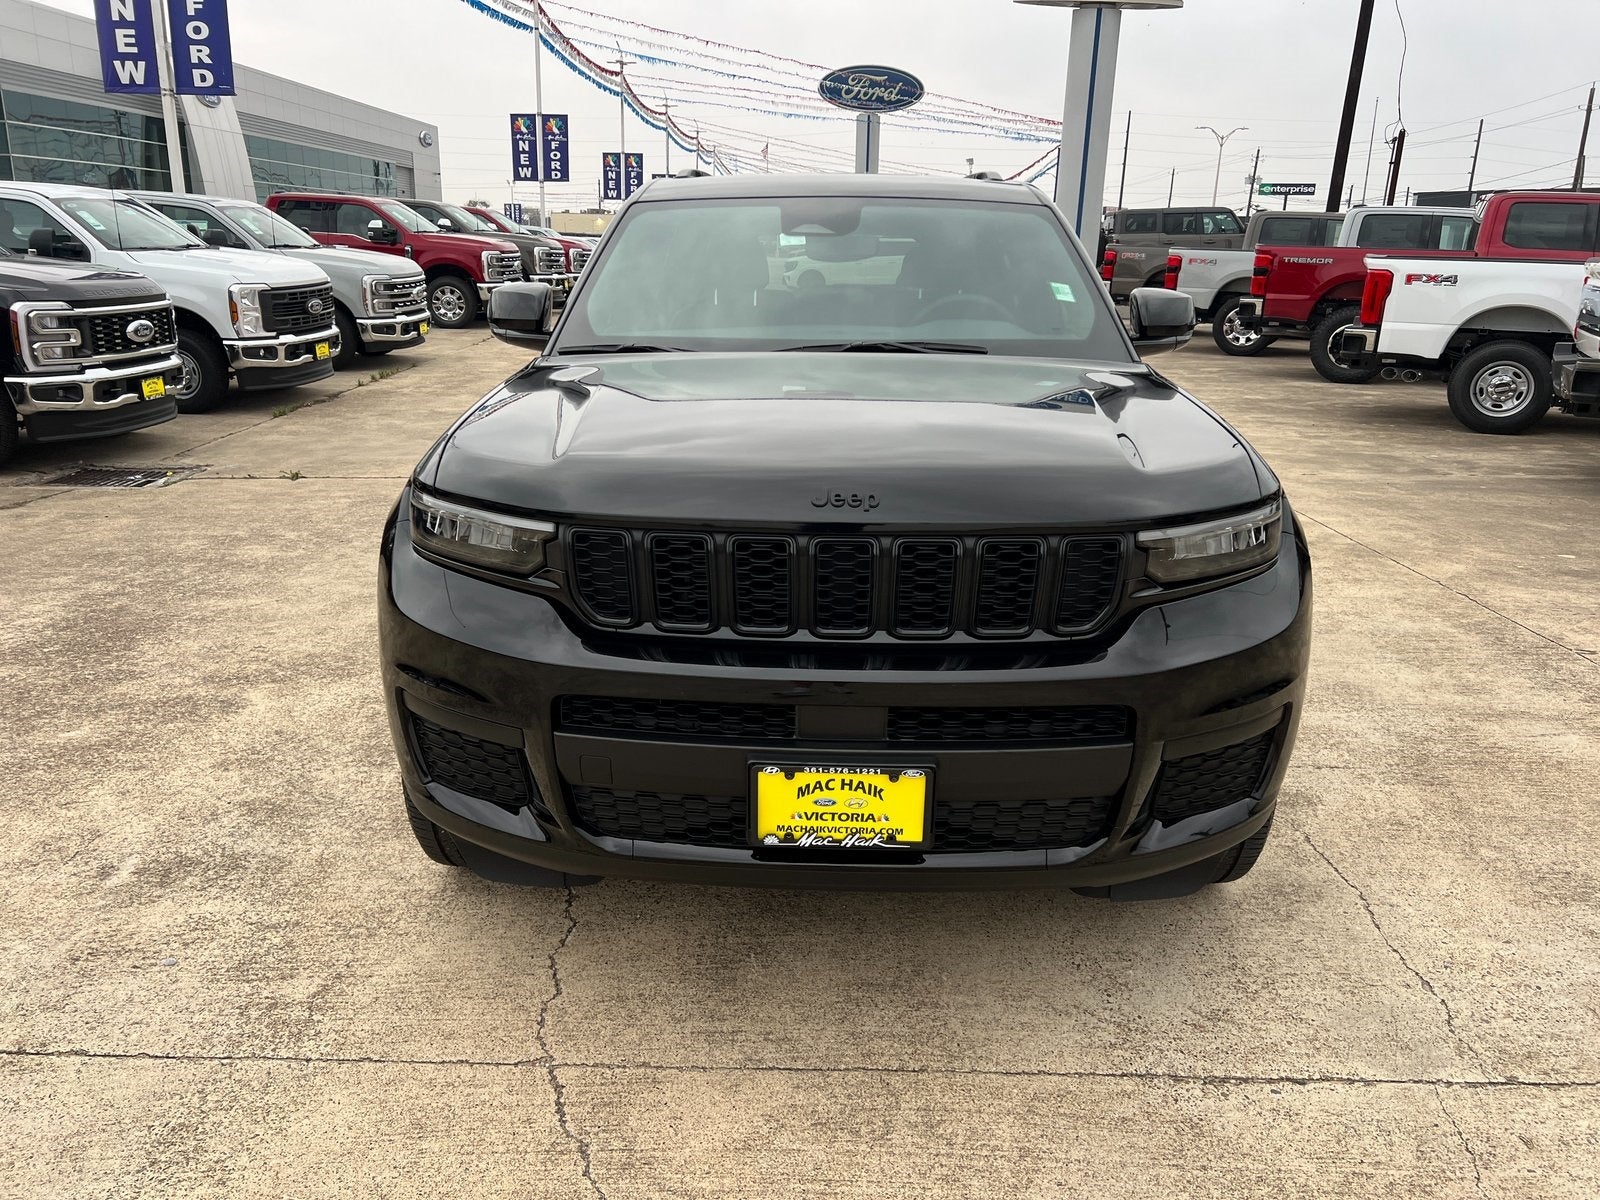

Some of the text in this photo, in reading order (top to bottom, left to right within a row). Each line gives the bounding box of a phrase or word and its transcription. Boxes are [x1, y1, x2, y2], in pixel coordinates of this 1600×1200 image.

[109, 0, 146, 85] NEW
[184, 0, 215, 88] FORD
[841, 73, 908, 101] Ford
[518, 140, 532, 178] NEW
[550, 141, 561, 179] FORD
[607, 171, 618, 198] NEW
[629, 171, 639, 195] FOR
[1262, 185, 1315, 194] enterprise
[1188, 258, 1217, 266] FX4
[1282, 256, 1334, 264] TREMOR
[1405, 273, 1458, 285] FX4
[810, 487, 880, 513] Jeep
[796, 778, 885, 801] MAC HAIK
[804, 811, 877, 823] VICTORIA
[797, 831, 890, 848] Mac Haik
